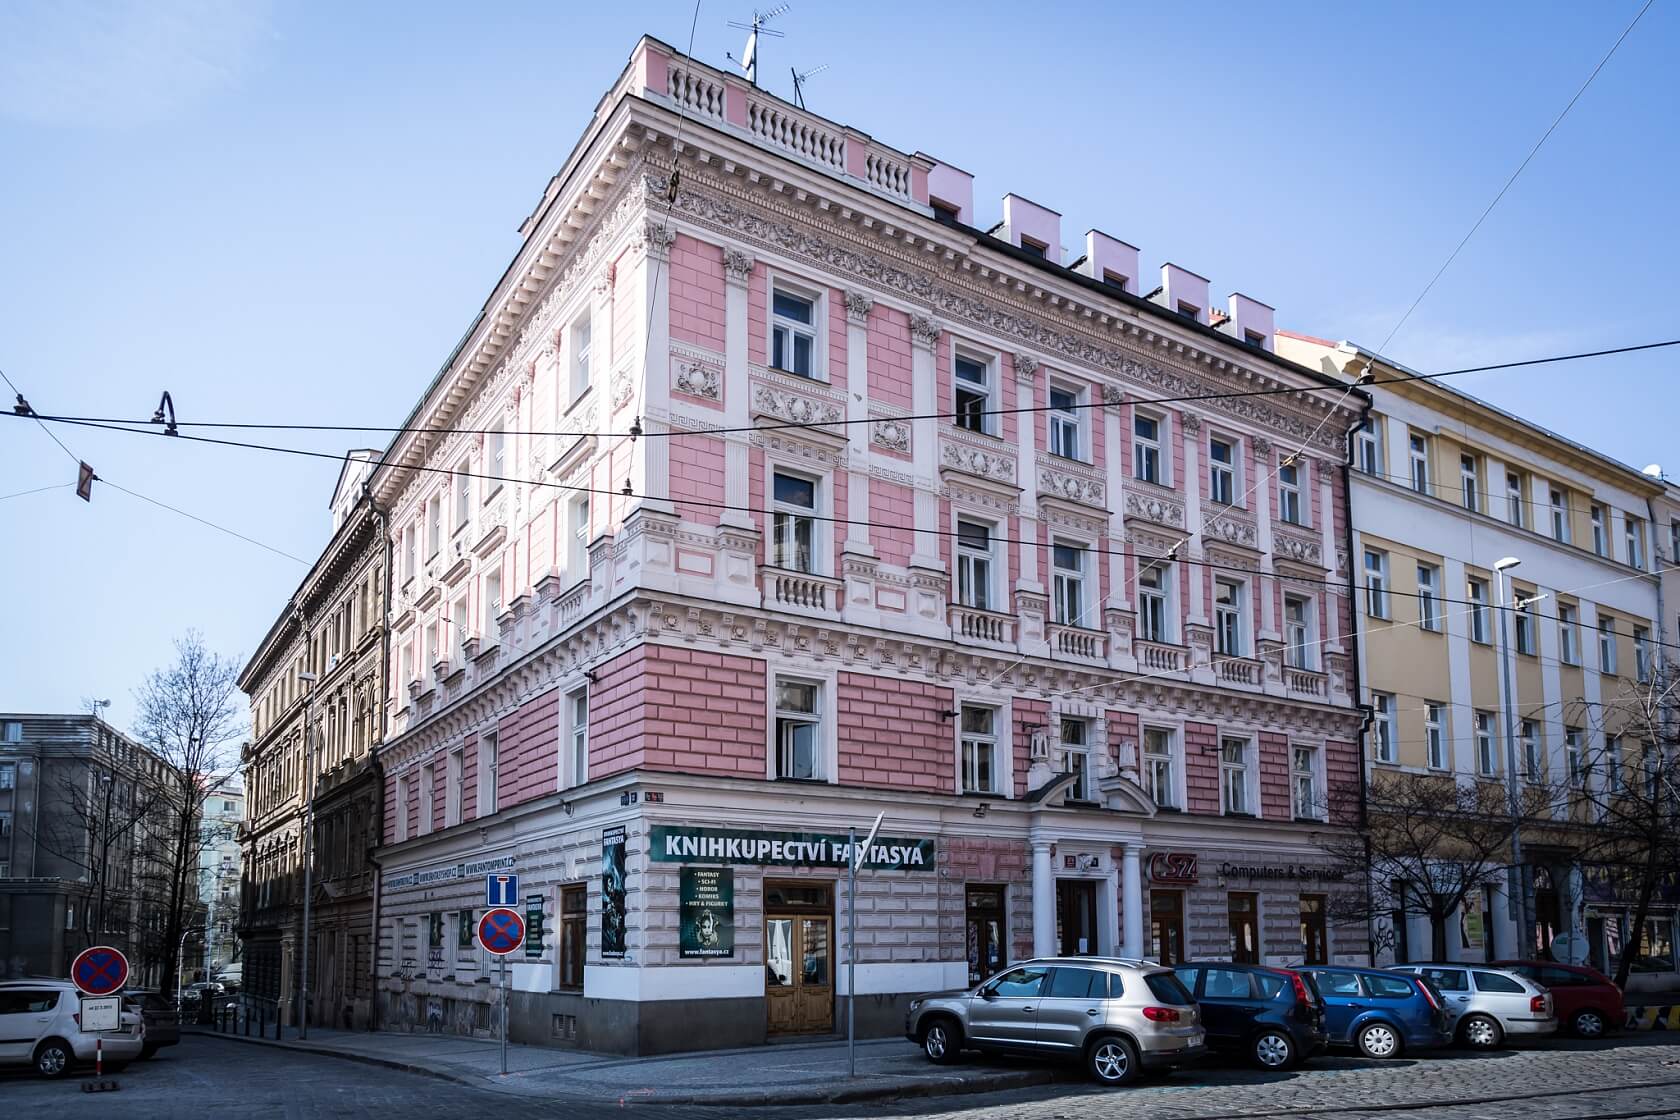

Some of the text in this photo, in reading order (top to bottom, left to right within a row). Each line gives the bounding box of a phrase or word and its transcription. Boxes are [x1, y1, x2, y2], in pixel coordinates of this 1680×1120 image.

[666, 835, 924, 865] KNIHKUPECTVÍ FANTASYA
[1222, 862, 1284, 880] Computers
[1288, 864, 1296, 878] &
